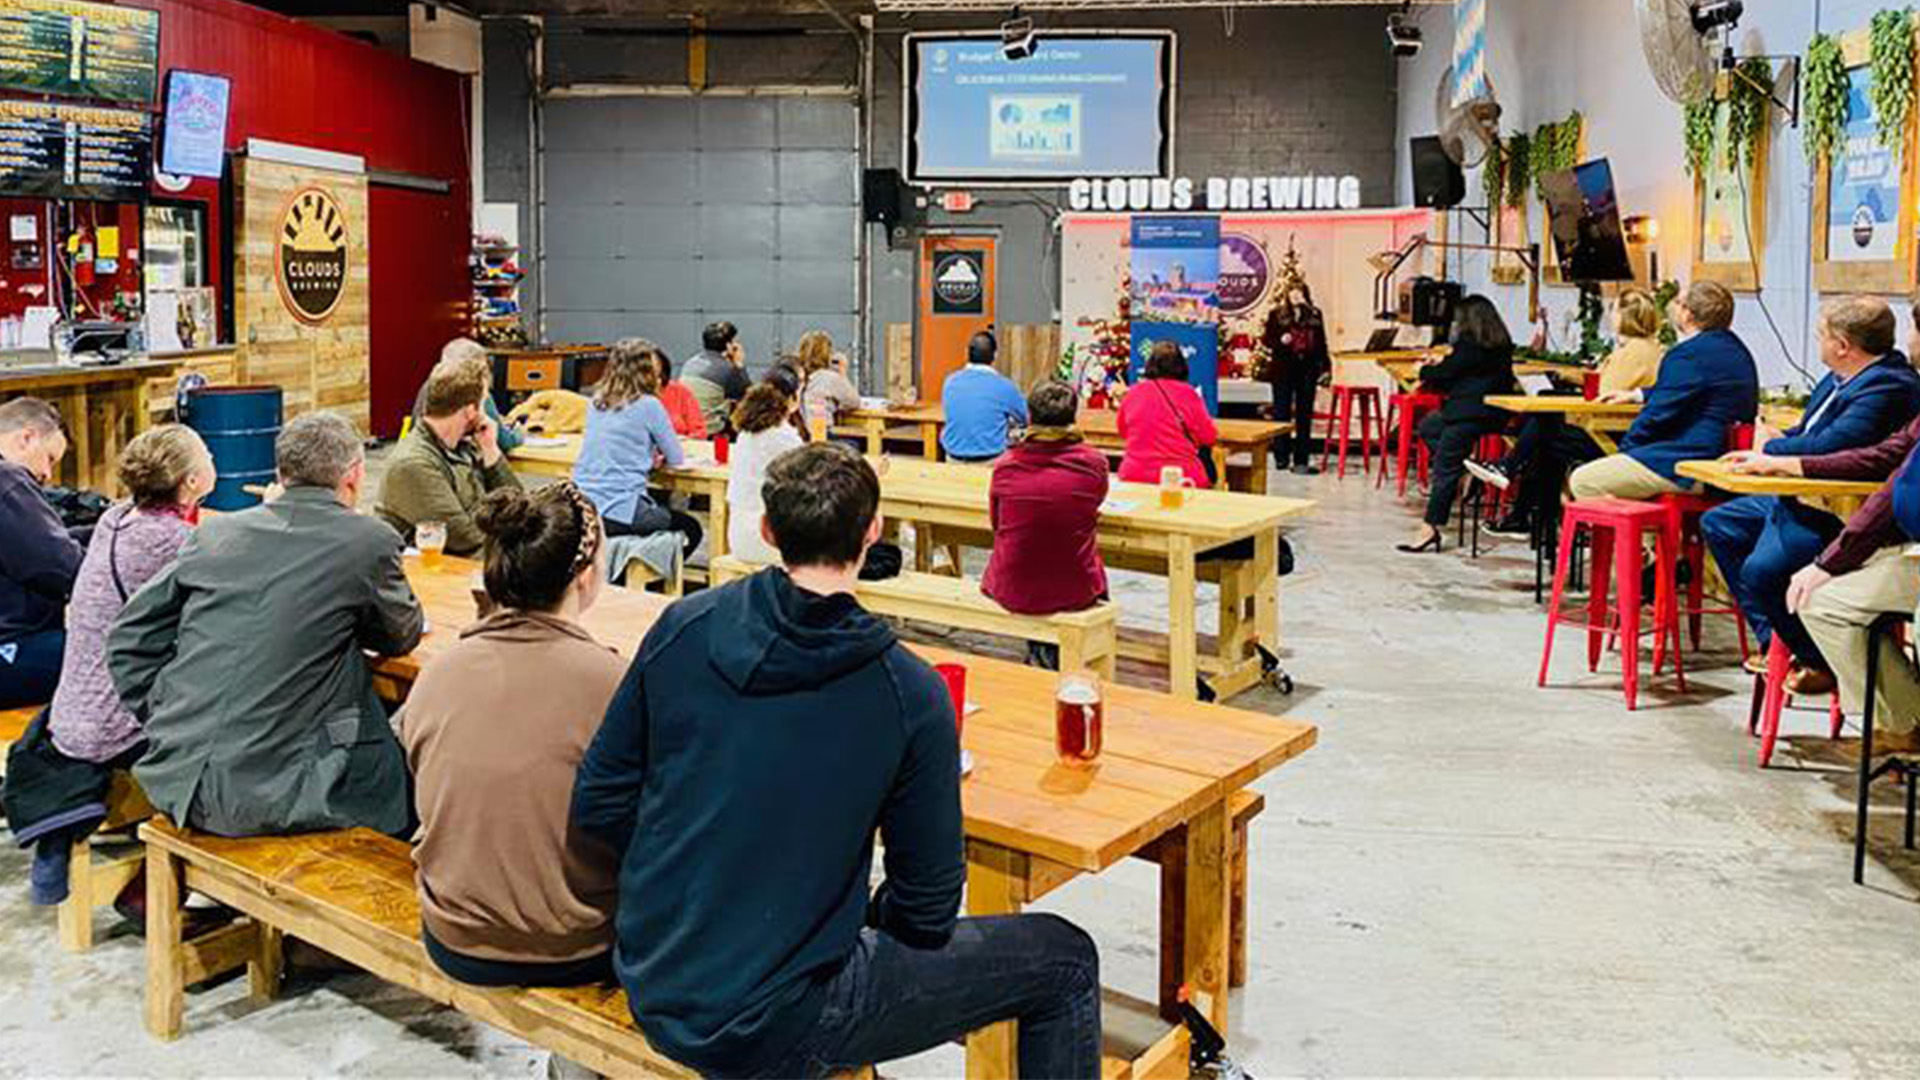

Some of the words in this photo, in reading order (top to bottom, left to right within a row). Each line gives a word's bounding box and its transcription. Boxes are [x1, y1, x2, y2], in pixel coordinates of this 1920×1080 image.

[1069, 177, 1193, 210] CLOUDS
[1206, 175, 1360, 210] BREWING
[288, 261, 341, 278] CLOUDS
